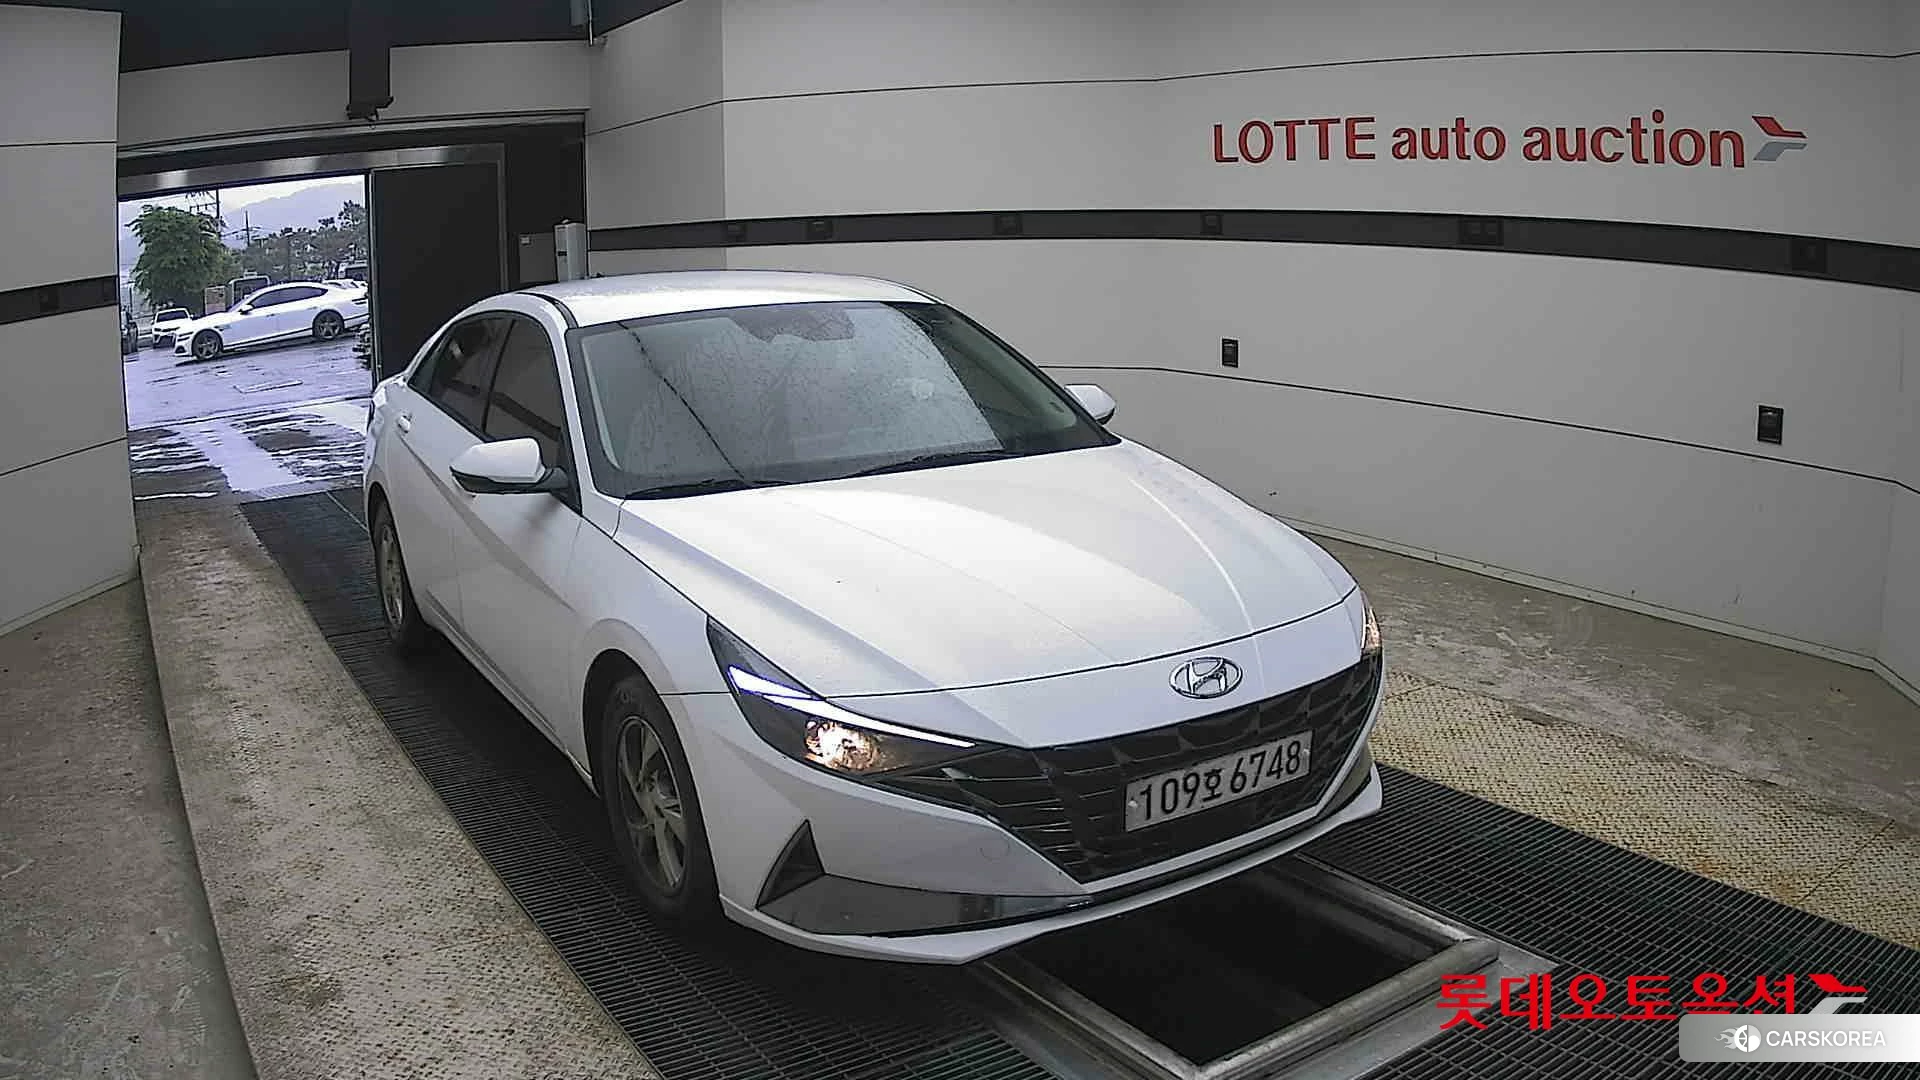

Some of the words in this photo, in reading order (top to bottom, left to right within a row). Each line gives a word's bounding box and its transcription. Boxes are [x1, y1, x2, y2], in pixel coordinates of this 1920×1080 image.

[1213, 117, 1376, 163] LOTTE
[1391, 117, 1506, 160] auto
[1522, 109, 1745, 168] auction
